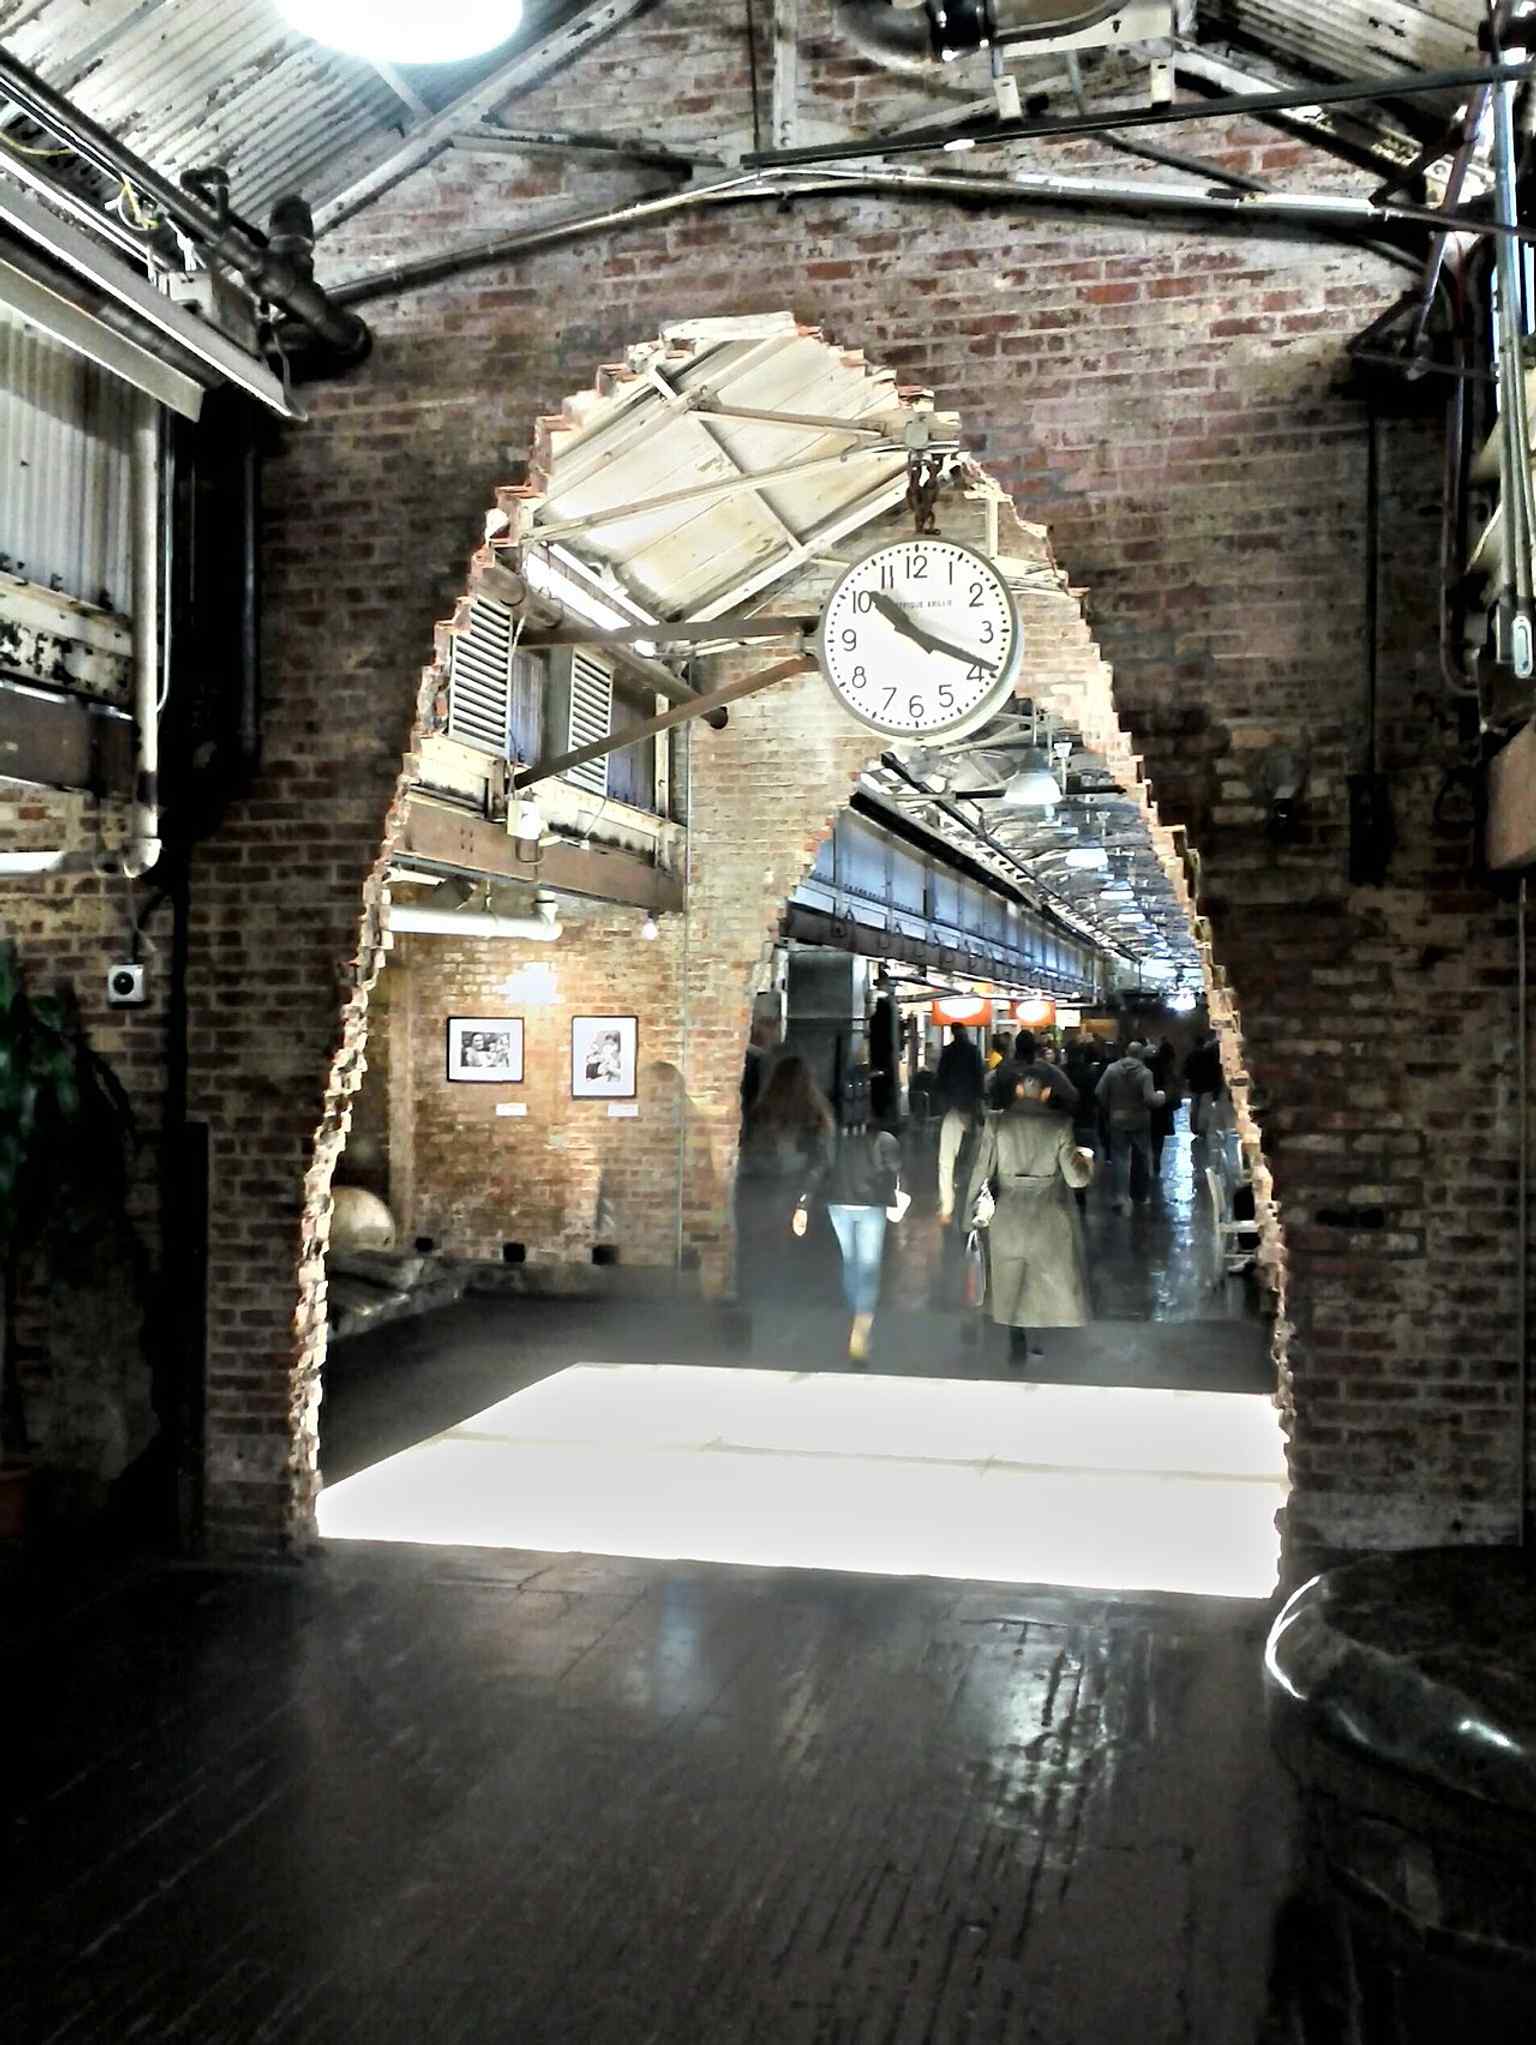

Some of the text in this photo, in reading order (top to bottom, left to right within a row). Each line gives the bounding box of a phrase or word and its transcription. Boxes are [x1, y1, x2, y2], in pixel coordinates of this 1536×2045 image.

[881, 565, 894, 589] 11
[906, 555, 928, 579] 12
[949, 561, 953, 585] 1
[852, 590, 872, 614] 10
[968, 582, 984, 607] 2
[841, 628, 857, 652] 9
[979, 620, 994, 644] 3
[851, 665, 867, 689] 8
[966, 661, 985, 683] 4
[881, 687, 897, 711] 7
[908, 695, 925, 718] 6
[938, 683, 954, 708] 5
